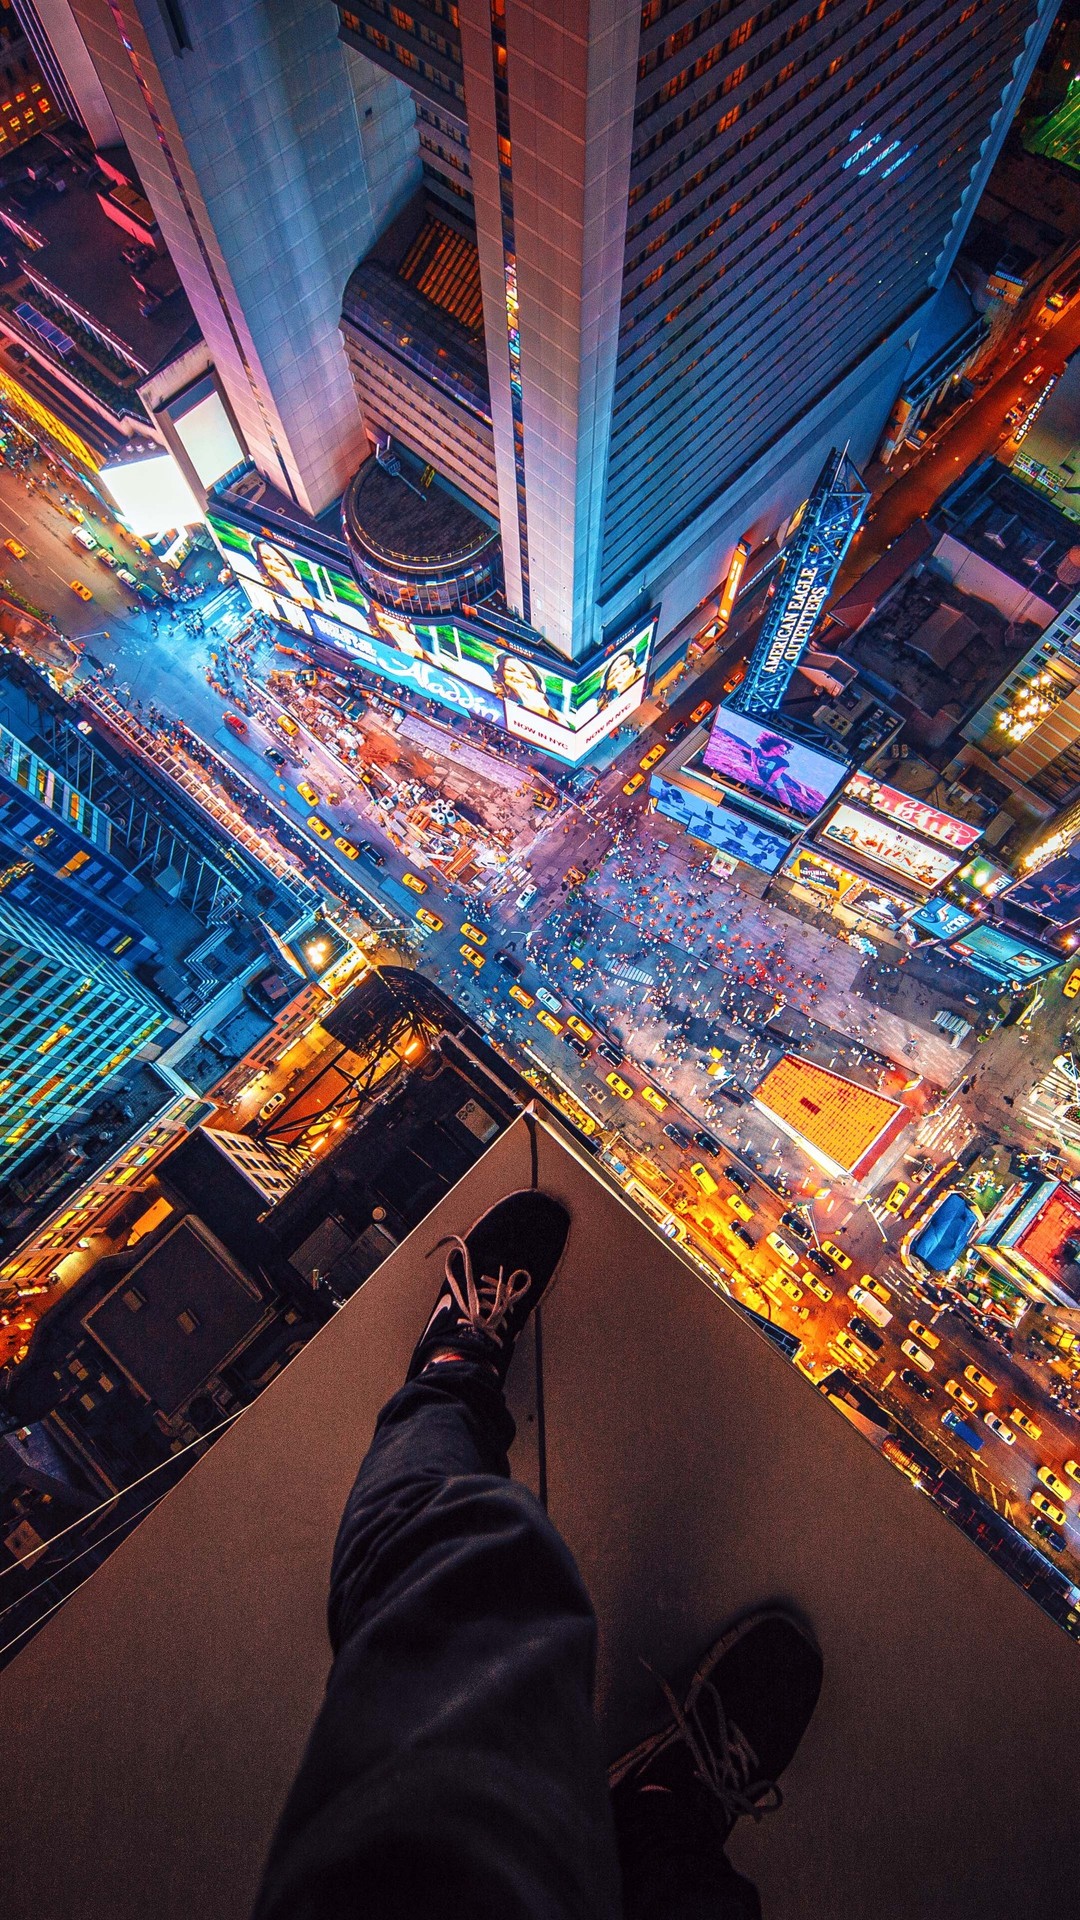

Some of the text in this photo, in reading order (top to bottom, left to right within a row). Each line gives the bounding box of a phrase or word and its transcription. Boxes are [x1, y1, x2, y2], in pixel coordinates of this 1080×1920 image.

[1015, 379, 1055, 441] SCIENTOLOGY
[762, 612, 800, 673] AMERICAN
[788, 567, 818, 611] EAGLE
[784, 586, 827, 660] OUTFITTERS
[376, 656, 502, 723] Aladdin
[513, 720, 569, 751] NOW IN NYC
[585, 703, 632, 743] NOW IN NYC
[953, 944, 972, 956] CNN
